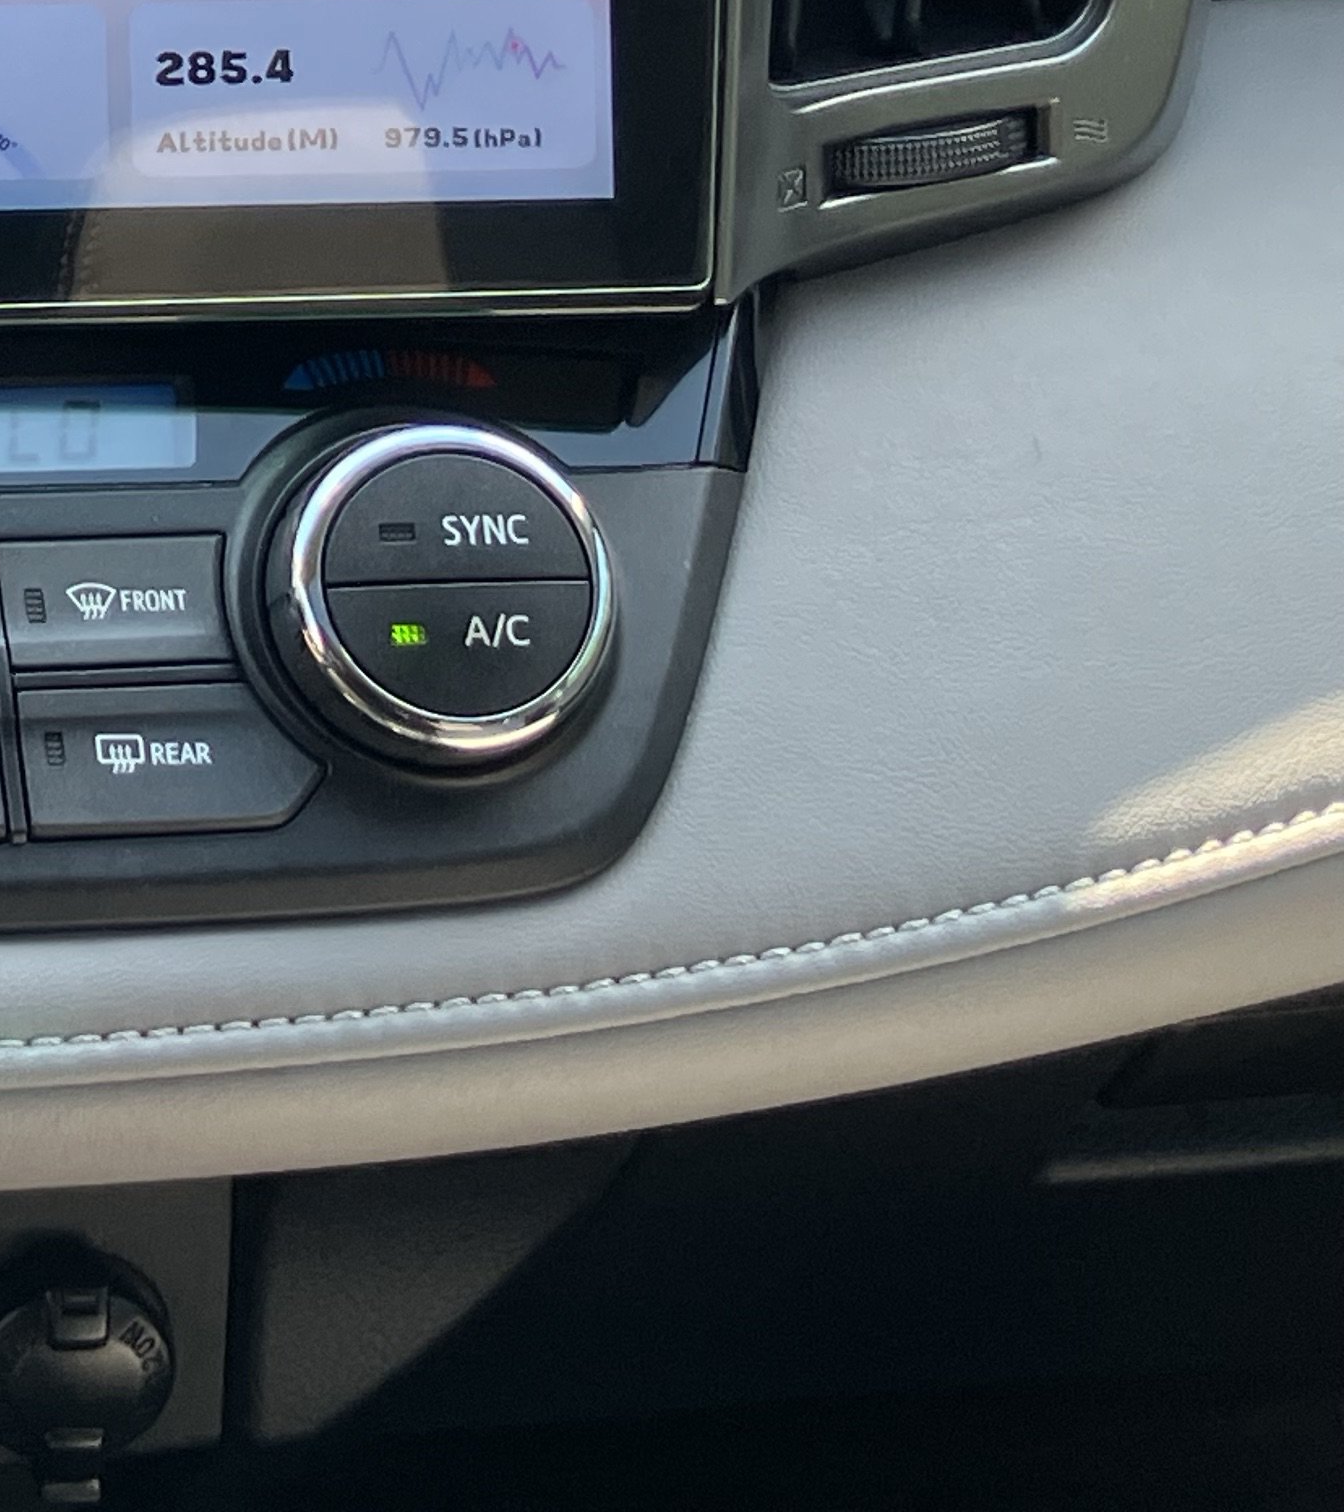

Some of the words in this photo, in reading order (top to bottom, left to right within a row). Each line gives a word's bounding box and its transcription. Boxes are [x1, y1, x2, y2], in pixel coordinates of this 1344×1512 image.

[154, 49, 295, 87] 285.4
[441, 514, 529, 547] SYNC
[120, 588, 187, 613] FRONT
[463, 615, 530, 649] A/C
[149, 739, 212, 767] REAR
